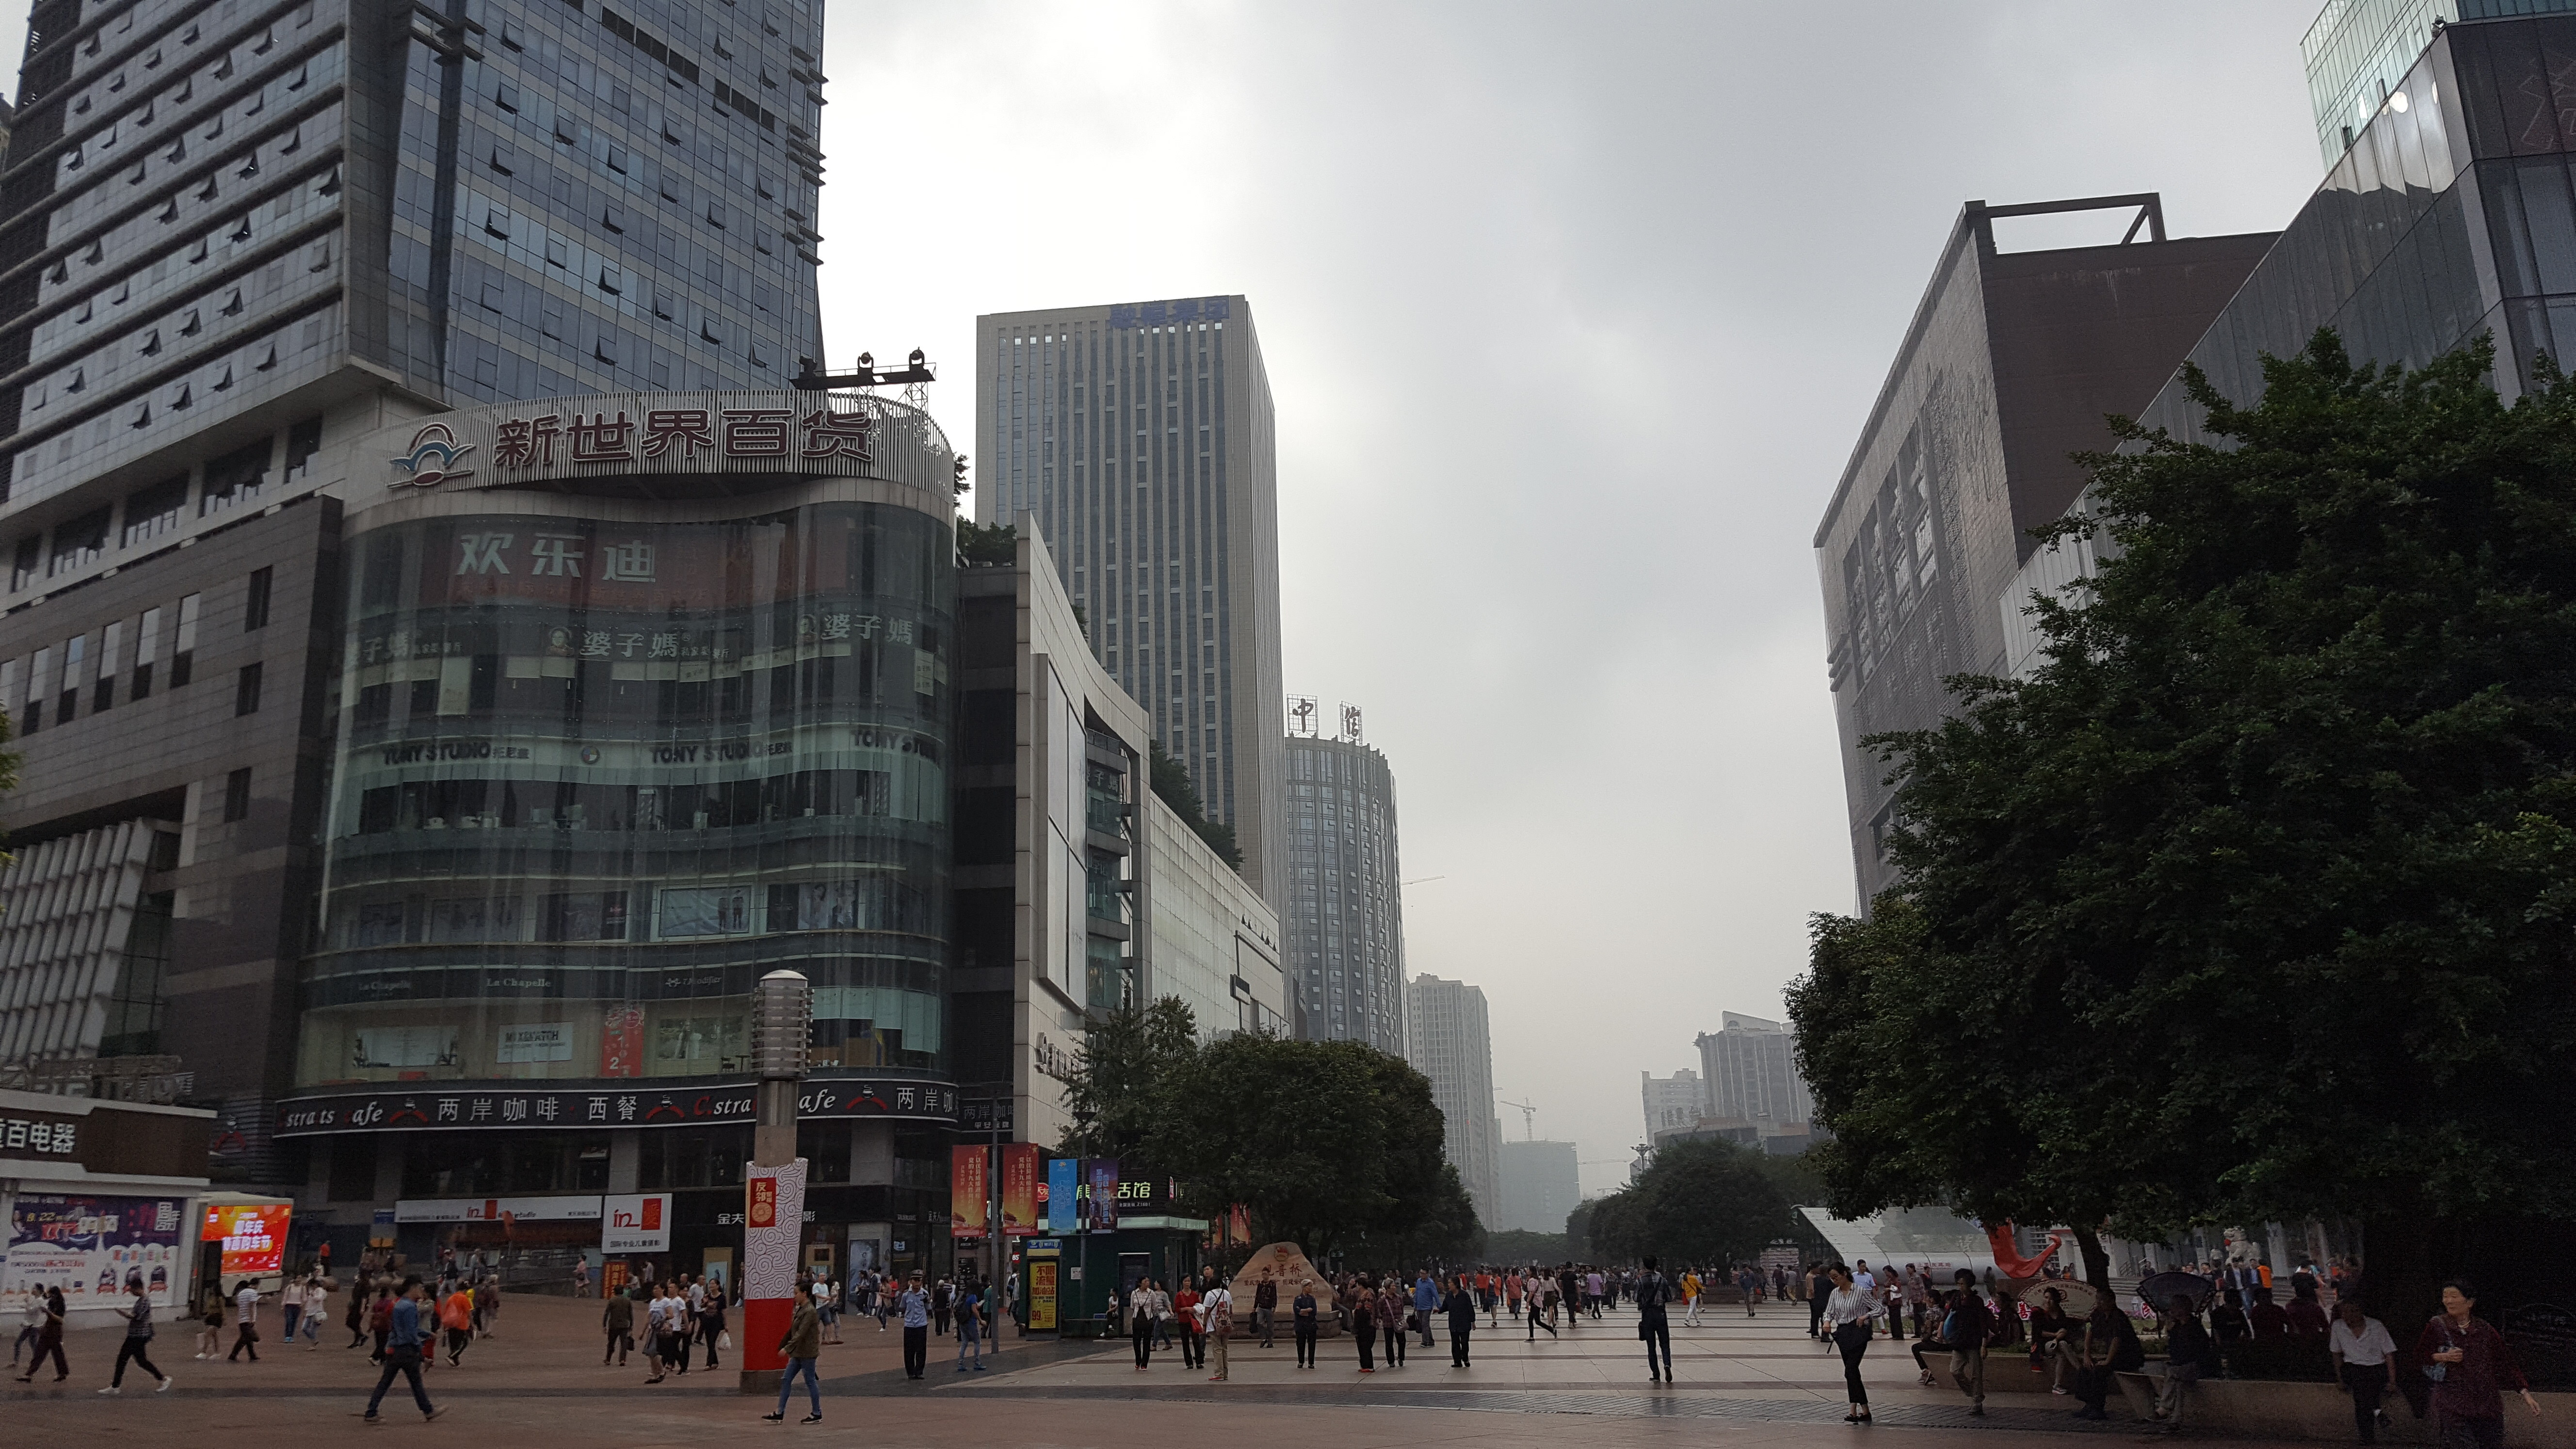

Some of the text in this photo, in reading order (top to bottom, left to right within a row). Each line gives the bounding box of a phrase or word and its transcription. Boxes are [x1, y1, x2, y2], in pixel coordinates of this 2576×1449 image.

[495, 408, 874, 468] 新世界百货
[455, 532, 656, 583] 欢乐迪
[652, 745, 698, 764] TONY
[486, 978, 551, 988] La Chapelle
[610, 1056, 620, 1069] 2
[437, 1095, 638, 1121] 两岸咖啡 西餐
[897, 1086, 959, 1115] 两岸咖
